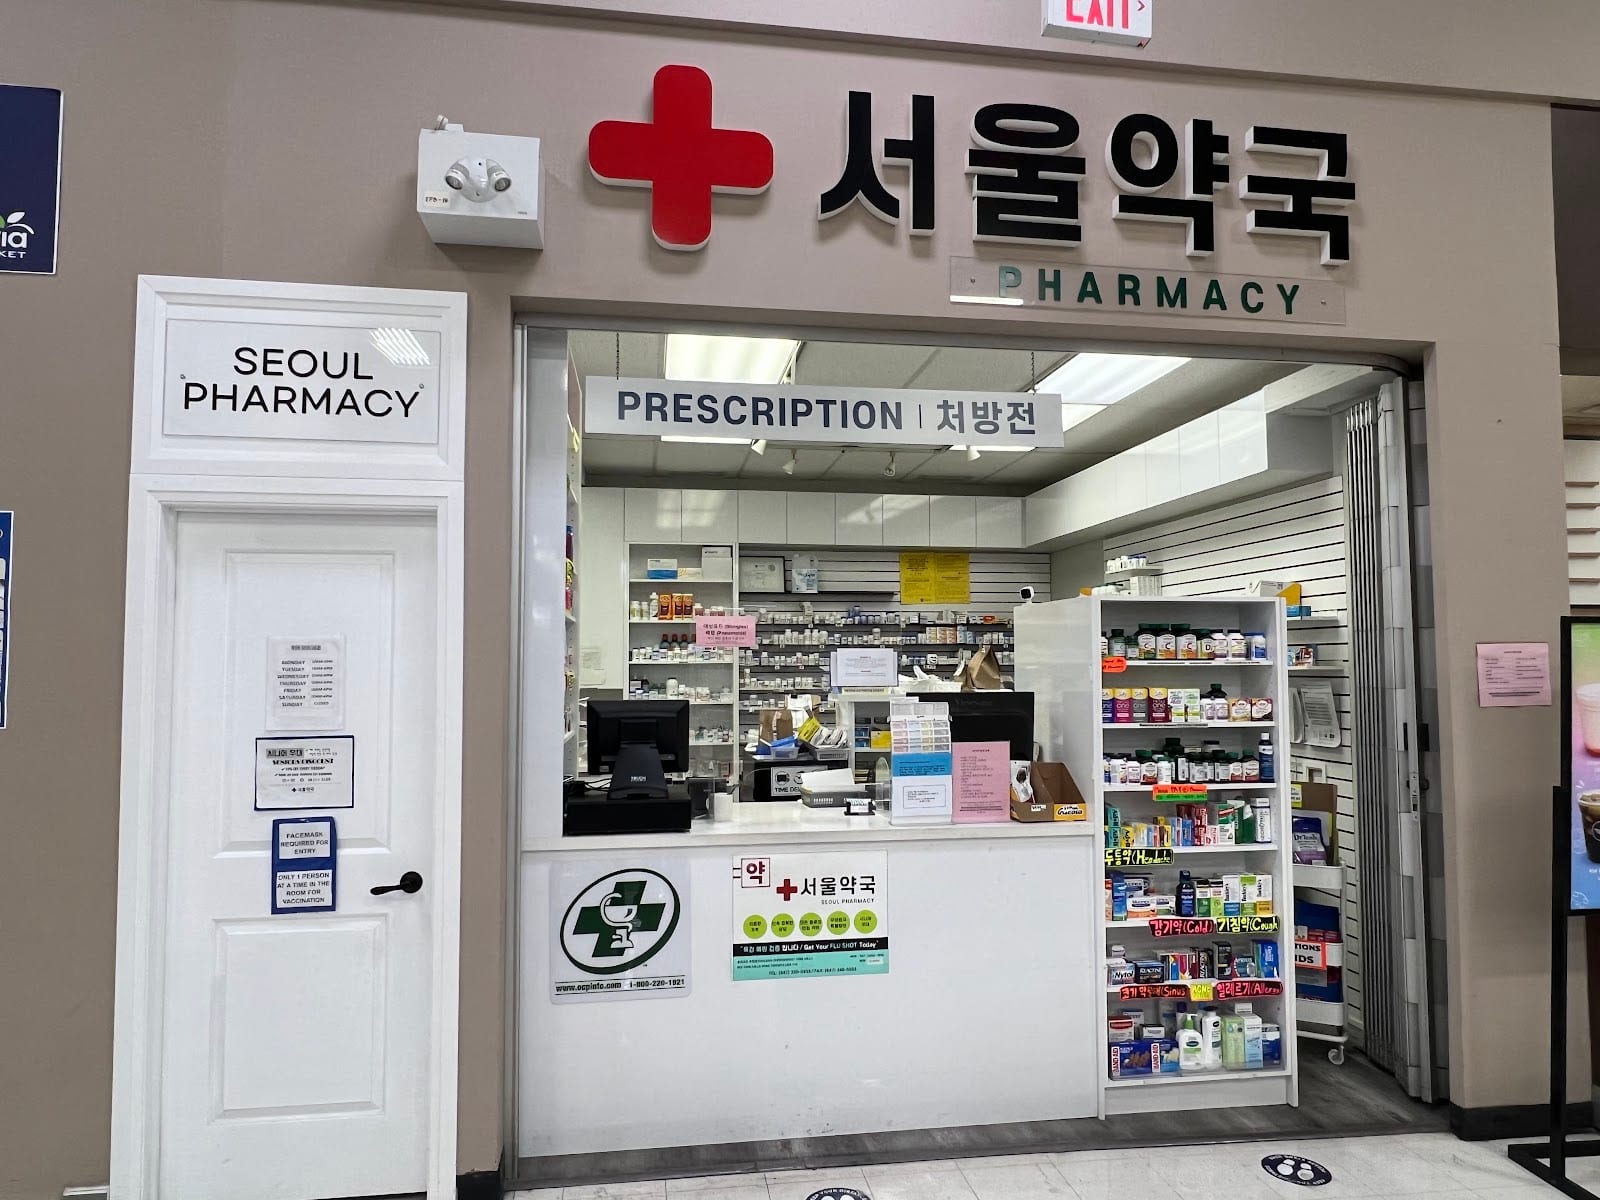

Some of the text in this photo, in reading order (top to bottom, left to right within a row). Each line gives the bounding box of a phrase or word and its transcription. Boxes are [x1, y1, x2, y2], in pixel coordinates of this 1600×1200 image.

[818, 90, 1357, 266] 서울약국
[0, 231, 28, 249] ia
[999, 266, 1303, 316] PHARMACY
[233, 346, 375, 382] SEOUL
[183, 382, 421, 419] PHARMACY
[617, 389, 1038, 438] PRESCRIPTION 처방전
[280, 840, 315, 848] REQUIRED
[746, 861, 766, 885] 약
[800, 875, 876, 898] 서울약국
[804, 943, 815, 951] Get
[1113, 970, 1134, 980] Nytol
[556, 982, 622, 992] www.ocpinfo.com
